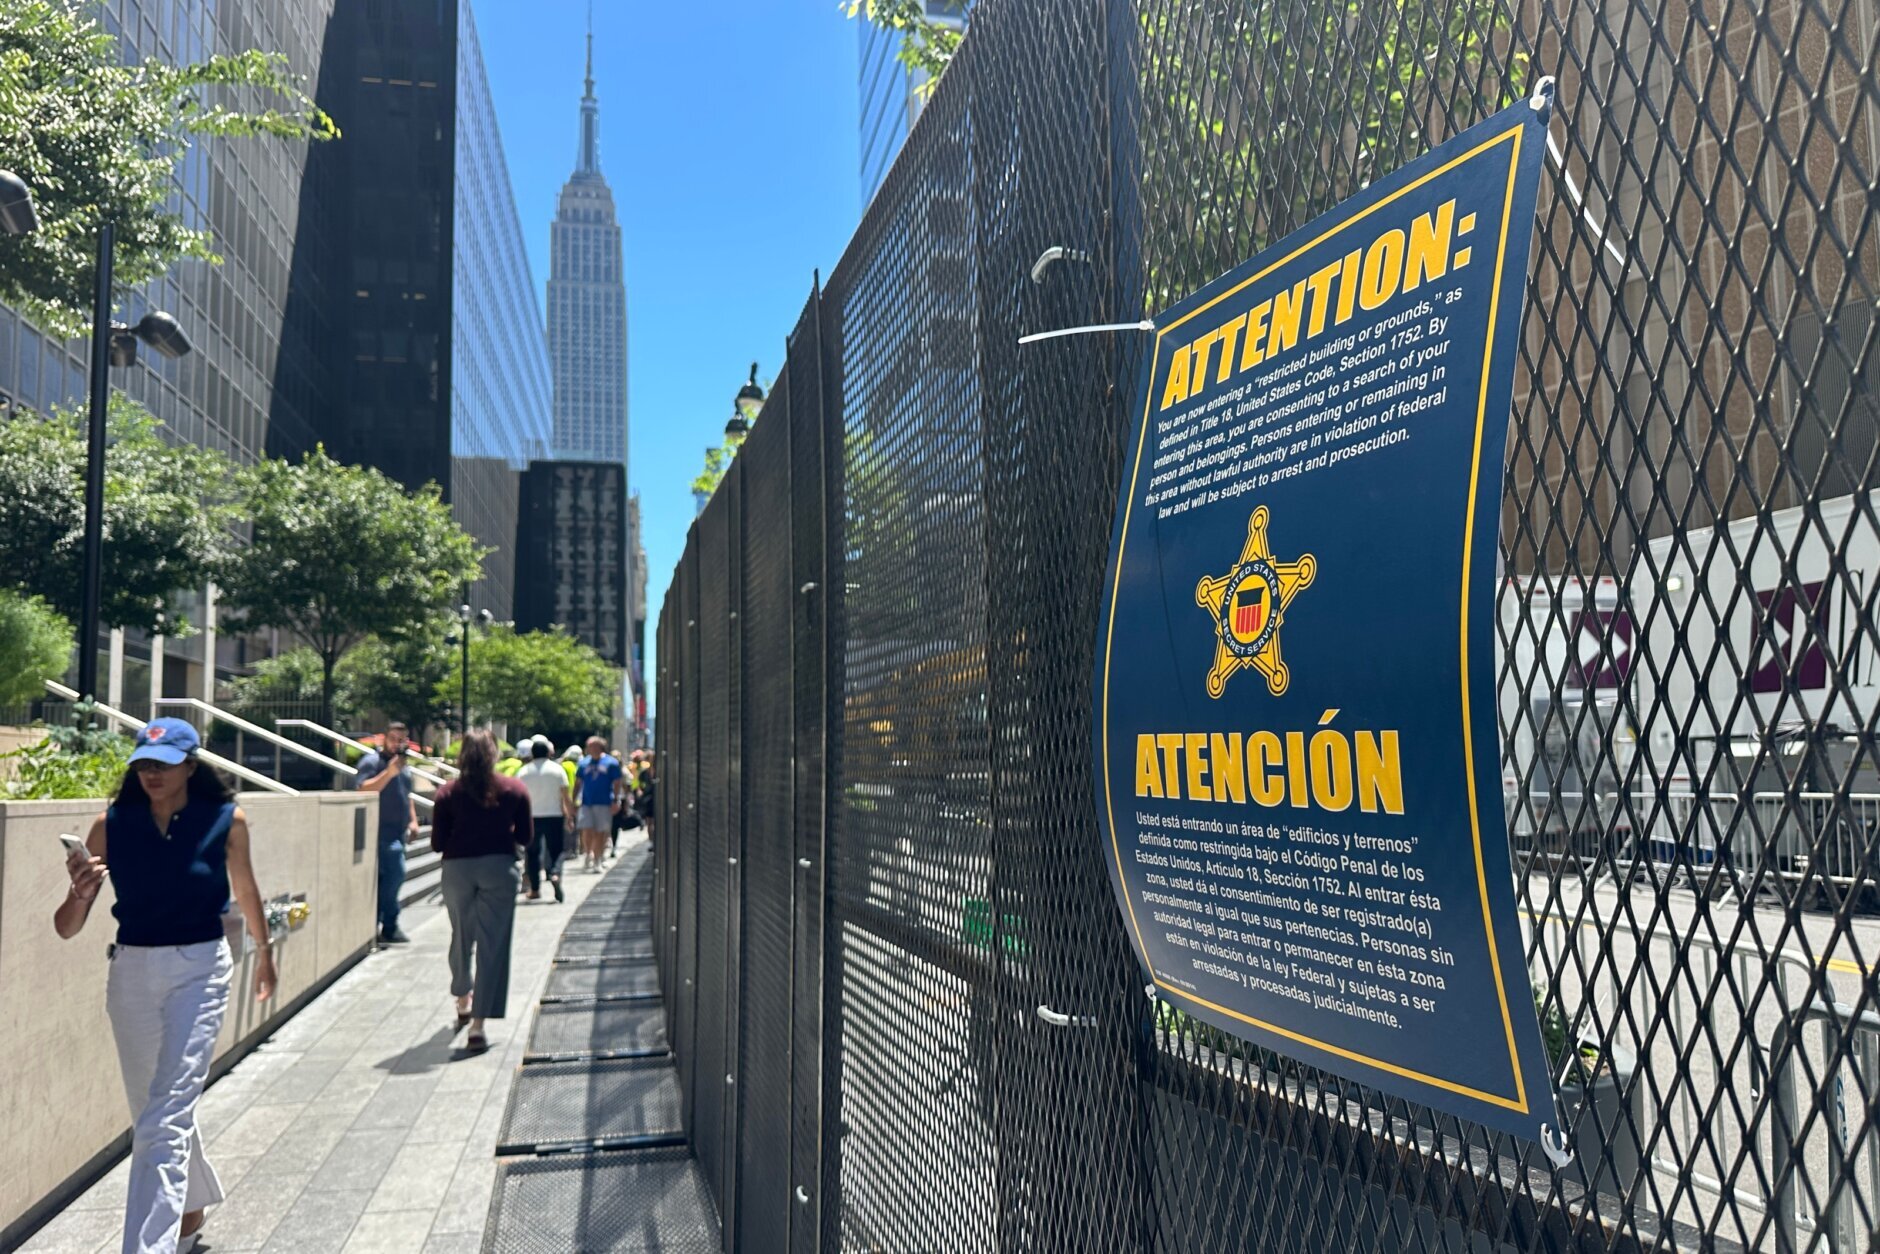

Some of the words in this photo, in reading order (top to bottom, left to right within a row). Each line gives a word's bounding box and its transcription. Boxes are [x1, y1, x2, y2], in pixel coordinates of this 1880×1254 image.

[1160, 198, 1477, 412] ATTENTION:
[1158, 422, 1171, 434] You
[1173, 415, 1186, 426] are
[1188, 407, 1205, 422] now
[1207, 387, 1244, 412] entering
[1245, 382, 1252, 394] a
[1309, 333, 1355, 365] building
[1358, 327, 1373, 342] or
[1445, 287, 1462, 304] as
[1159, 429, 1188, 450] defined
[1190, 424, 1199, 436] in
[1201, 414, 1219, 433] Title
[1221, 408, 1234, 423] 18,
[1236, 392, 1267, 417] United
[1269, 378, 1302, 403] States
[1304, 364, 1336, 387] Code,
[1340, 342, 1386, 372] Section
[1390, 325, 1424, 350] 1752.
[1428, 316, 1449, 336] By
[1149, 472, 1177, 491] person
[1178, 461, 1195, 476] and
[1196, 442, 1248, 470] belongings.
[1250, 422, 1293, 450] Persons
[1295, 405, 1342, 431] entering
[1345, 398, 1359, 413] or
[1361, 372, 1428, 408] remaining
[1432, 365, 1445, 382] in
[1153, 449, 1185, 470] entering
[1187, 440, 1203, 457] this
[1204, 433, 1226, 449] area,
[1227, 427, 1246, 442] you
[1247, 417, 1263, 431] are
[1266, 390, 1325, 424] consenting
[1327, 383, 1339, 399] to
[1342, 380, 1350, 392] a
[1353, 359, 1395, 388] search
[1399, 349, 1414, 370] of
[1416, 339, 1451, 368] your
[1145, 493, 1160, 507] this
[1160, 485, 1178, 501] area
[1180, 473, 1212, 496] without
[1212, 460, 1241, 482] lawful
[1242, 446, 1288, 472] authority
[1289, 440, 1308, 455] are
[1310, 433, 1321, 448] in
[1325, 411, 1381, 443] violation
[1380, 405, 1395, 424] of
[1397, 386, 1447, 417] federal
[1158, 506, 1172, 520] law
[1173, 498, 1189, 514] and
[1191, 492, 1207, 509] will
[1207, 487, 1220, 500] be
[1220, 475, 1256, 499] subject
[1258, 473, 1269, 487] to
[1270, 460, 1302, 481] arrest
[1305, 452, 1327, 471] and
[1329, 428, 1410, 468] prosecution.
[1224, 565, 1251, 606] UNITED
[1253, 563, 1278, 597] STATES
[1222, 618, 1246, 655] SECRET
[1247, 608, 1278, 655] SERVICE
[1135, 708, 1405, 815] ATENCIÓN
[1136, 811, 1160, 827] Usted
[1162, 815, 1180, 829] está
[1182, 818, 1223, 834] entrando
[1226, 822, 1239, 836] un
[1241, 821, 1264, 838] área
[1266, 823, 1280, 839] de
[1342, 834, 1351, 851] y
[1138, 831, 1171, 848] definida
[1173, 838, 1198, 852] como
[1200, 840, 1252, 860] restringida
[1254, 845, 1278, 865] bajo
[1281, 849, 1291, 864] el
[1294, 850, 1338, 873] Código
[1340, 855, 1378, 876] Penal
[1381, 860, 1399, 878] de
[1401, 862, 1425, 882] los
[1135, 850, 1168, 868] Estados
[1169, 854, 1205, 874] Unidos,
[1246, 865, 1263, 885] 18,
[1264, 868, 1310, 891] Sección
[1312, 876, 1345, 896] 1752.
[1348, 881, 1361, 899] Al
[1365, 886, 1406, 905] entrar
[1409, 890, 1441, 911] ésta
[1146, 872, 1169, 888] zona,
[1169, 877, 1193, 892] usted
[1195, 880, 1208, 894] dá
[1209, 882, 1219, 896] el
[1220, 886, 1301, 912] consentimiento
[1303, 898, 1318, 915] de
[1321, 904, 1341, 919] ser
[1344, 906, 1433, 940] registrado(a)
[1141, 890, 1203, 914] personalmente
[1204, 901, 1213, 915] al
[1215, 902, 1239, 922] igual
[1240, 910, 1261, 926] que
[1262, 914, 1283, 930] sus
[1285, 920, 1359, 947] pertenecias.
[1361, 931, 1427, 961] Personas
[1430, 946, 1455, 966] sin
[1153, 910, 1192, 930] autoridad
[1193, 918, 1216, 938] legal
[1217, 925, 1239, 942] para
[1240, 932, 1271, 950] entrar
[1274, 939, 1282, 952] o
[1284, 941, 1353, 969] permanecer
[1357, 958, 1373, 974] en
[1377, 960, 1406, 982] ésta
[1409, 970, 1445, 990] zona
[1165, 932, 1188, 947] están
[1189, 937, 1201, 950] en
[1202, 941, 1244, 964] violación
[1247, 951, 1259, 968] de
[1260, 954, 1272, 971] la
[1273, 956, 1289, 979] ley
[1291, 962, 1335, 989] Federal
[1337, 977, 1346, 995] y
[1349, 979, 1397, 1004] sujetas
[1400, 992, 1409, 1007] a
[1412, 995, 1436, 1014] ser
[1192, 958, 1240, 982] arrestadas
[1240, 972, 1248, 988] y
[1250, 975, 1311, 1004] procesadas
[1312, 990, 1402, 1029] judicialmente.
